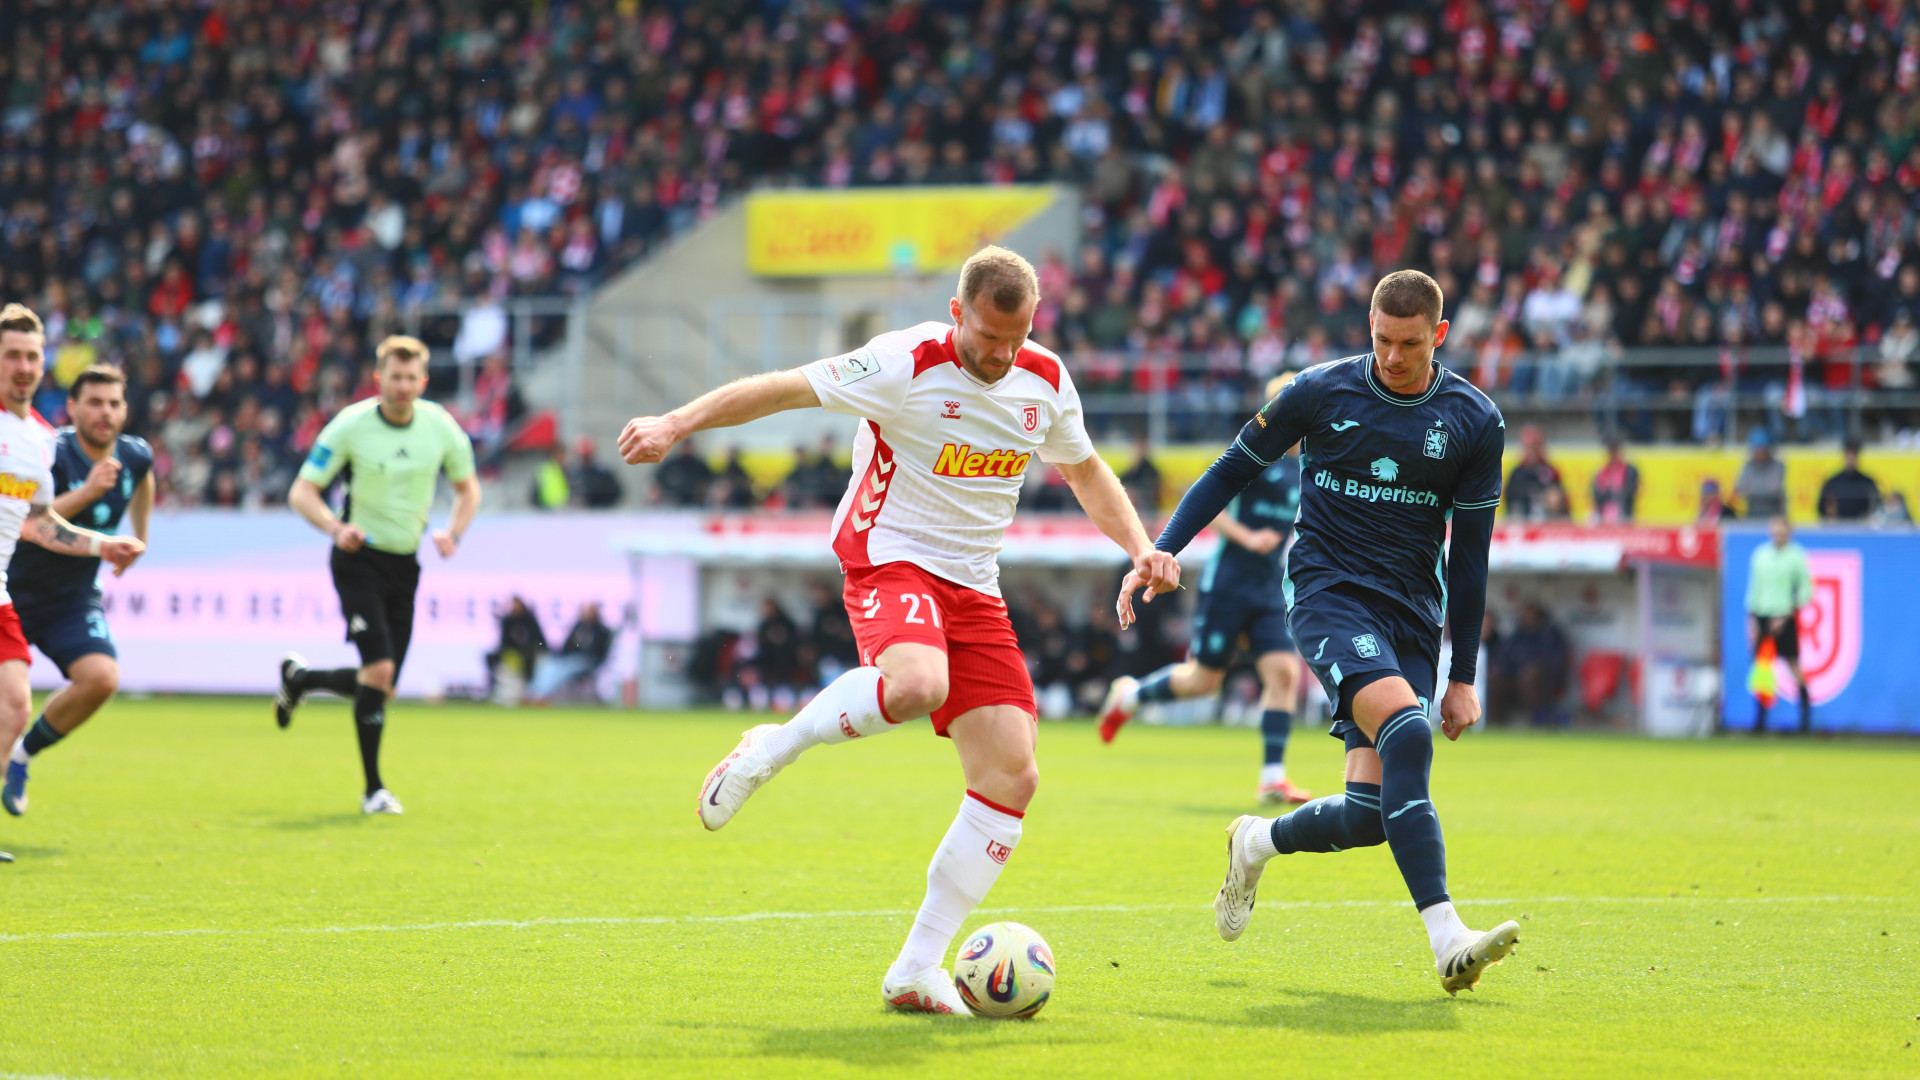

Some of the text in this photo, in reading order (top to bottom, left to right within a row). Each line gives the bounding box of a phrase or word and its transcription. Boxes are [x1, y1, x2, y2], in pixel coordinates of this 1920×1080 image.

[932, 443, 1031, 478] Netto
[0, 472, 39, 500] Nett
[1314, 469, 1439, 508] die Bayerisch
[899, 593, 940, 629] 21
